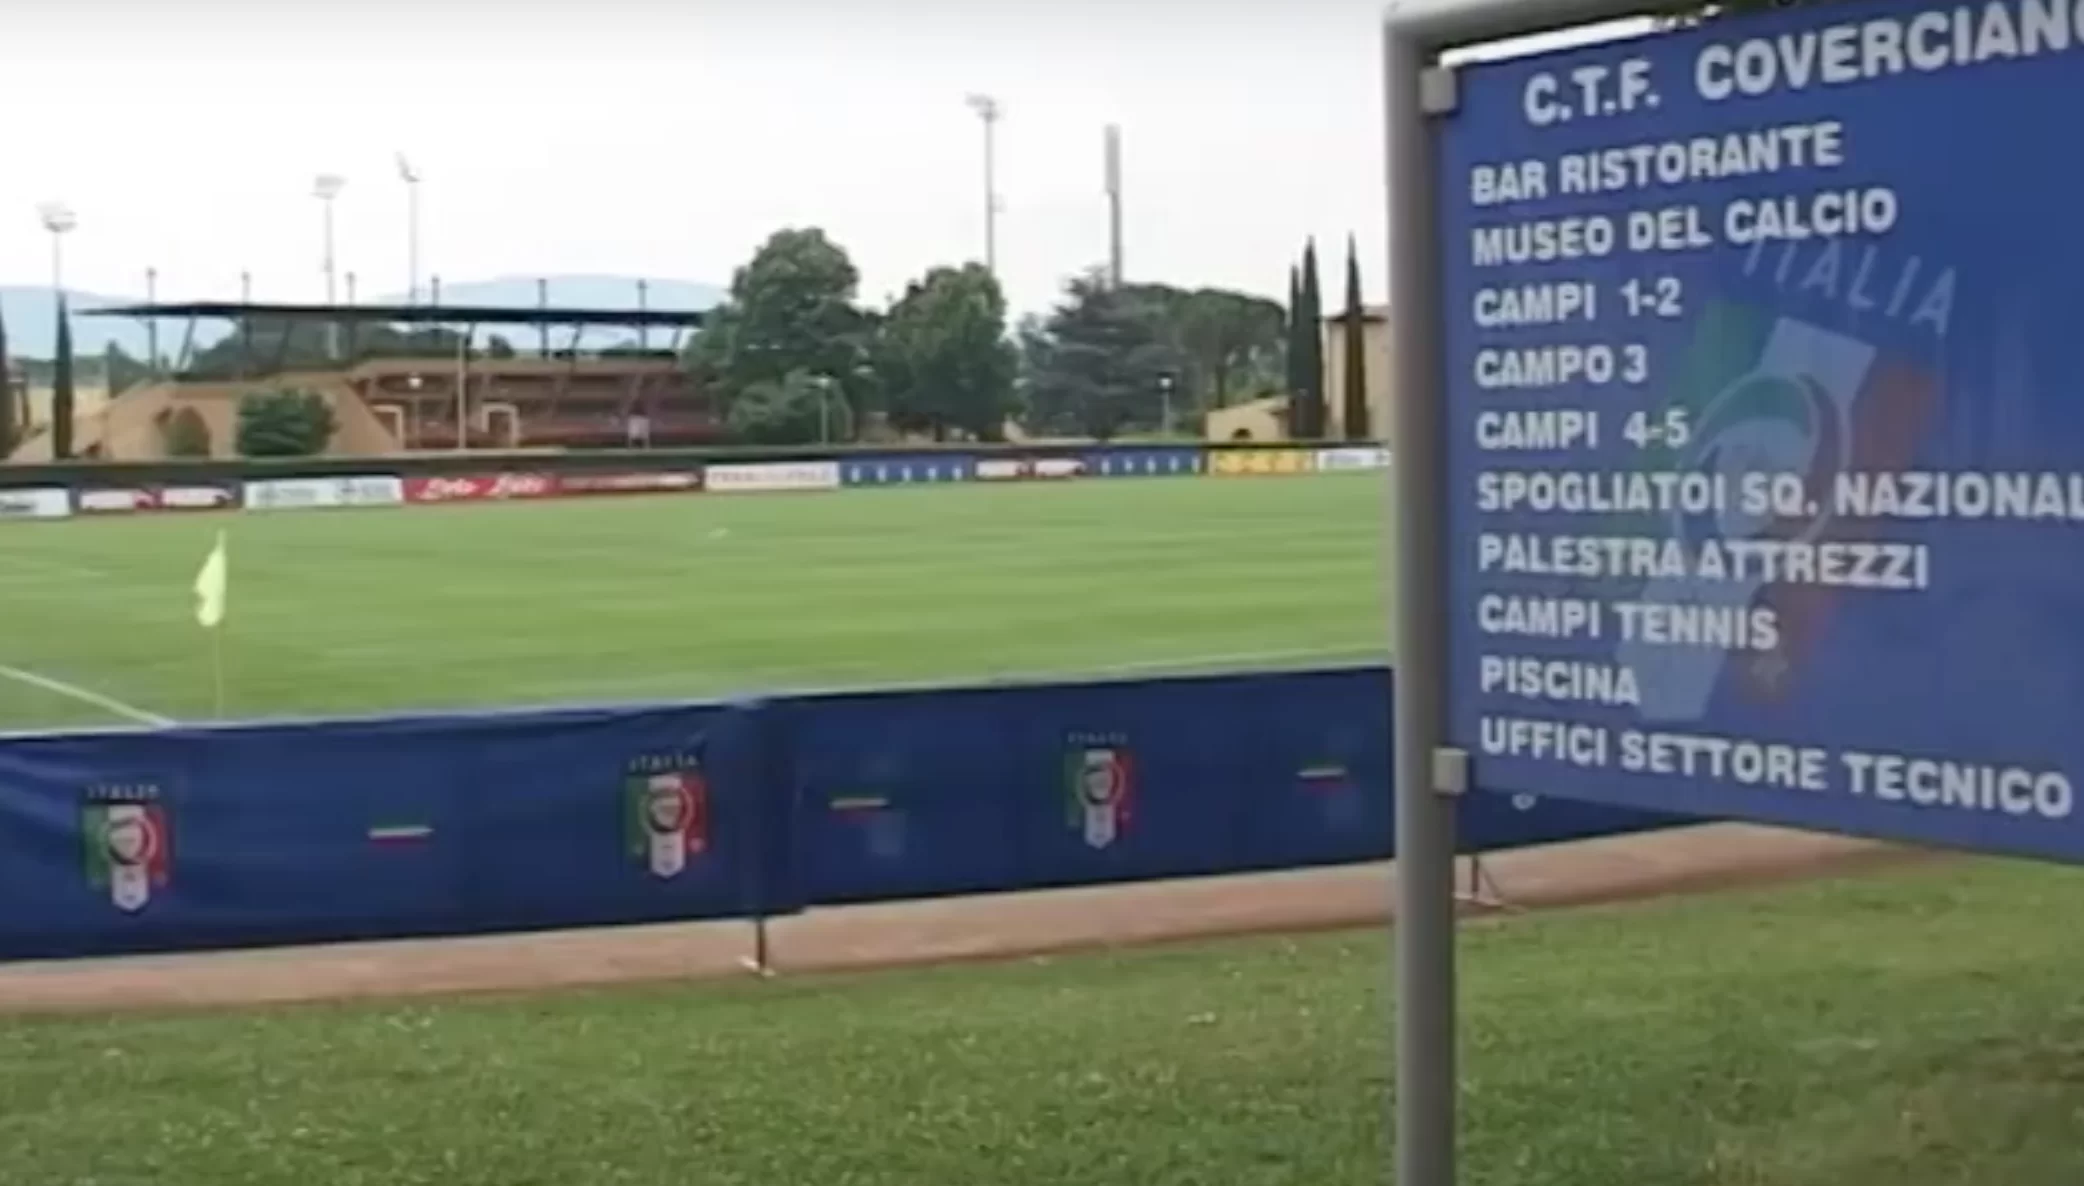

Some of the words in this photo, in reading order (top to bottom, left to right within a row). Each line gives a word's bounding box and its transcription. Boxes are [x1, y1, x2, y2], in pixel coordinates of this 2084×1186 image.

[1524, 62, 1660, 124] C.T.F.
[1696, 0, 2084, 100] COVERCIAN
[1471, 161, 1546, 204] BAR
[1561, 122, 1842, 192] RISTORANTE
[1472, 217, 1613, 265] MUSEO
[1628, 207, 1711, 250] DEL
[1724, 188, 1896, 244] CALCIO
[1474, 284, 1594, 326] CAMPI
[1621, 278, 1682, 317] 1-2
[1475, 347, 1612, 387] CAMPO
[1622, 345, 1648, 383] 3
[1476, 412, 1596, 449] CAMPI
[1622, 411, 1690, 447] 4-5
[1477, 473, 1726, 512] SPOGLIATOI
[1740, 473, 1818, 515] SQ.
[1478, 535, 1685, 576] PALESTRA
[1699, 540, 1929, 589] ATTREZZI
[1479, 595, 1599, 638] CAMPI
[1613, 603, 1779, 649] TENNIS
[1481, 657, 1640, 704] PISCINA
[1481, 717, 1606, 766] UFFICI
[1621, 730, 1827, 791] SETTORE
[1842, 753, 2072, 817] TECNICO
